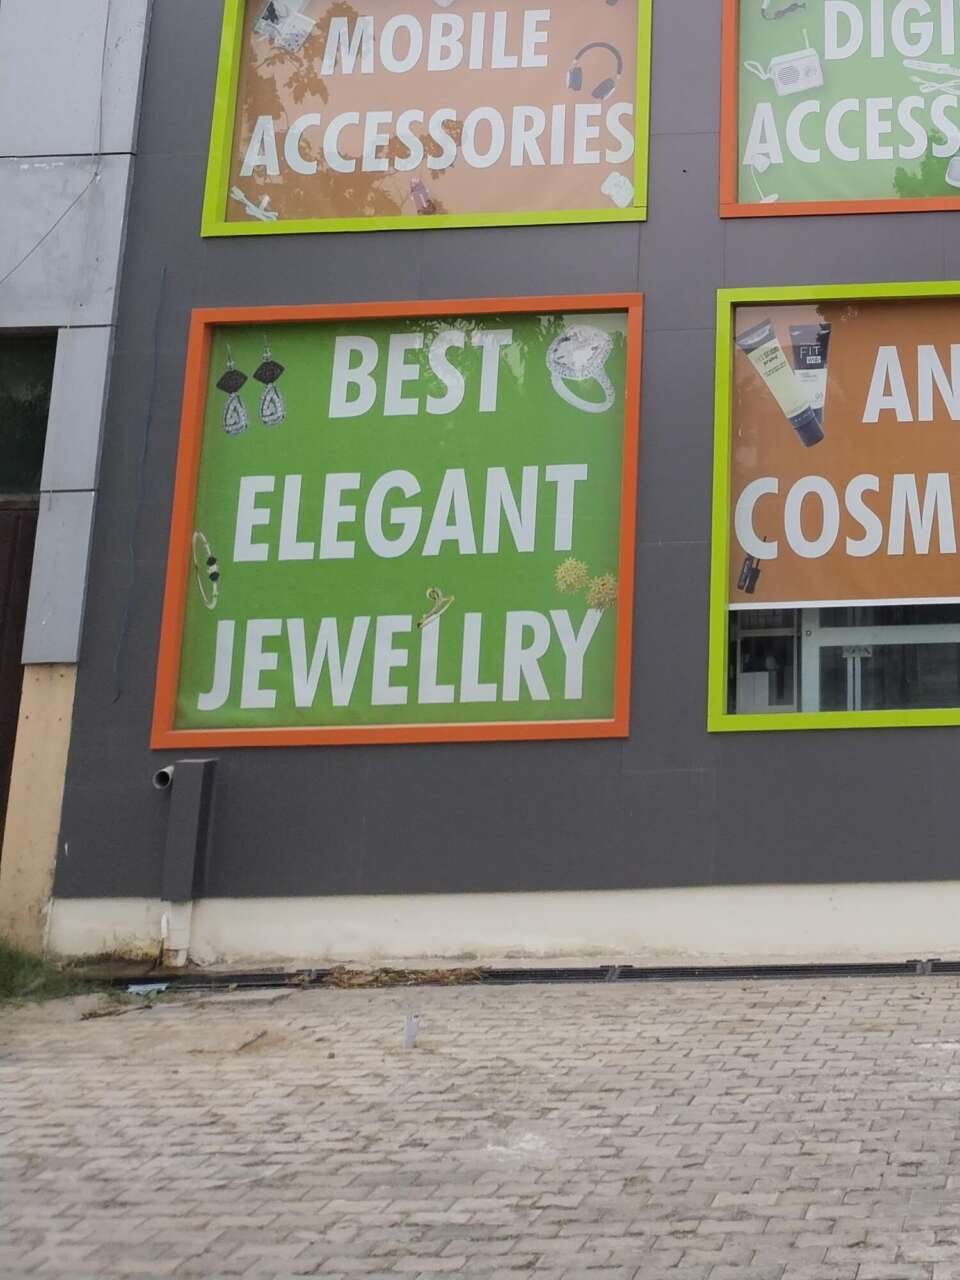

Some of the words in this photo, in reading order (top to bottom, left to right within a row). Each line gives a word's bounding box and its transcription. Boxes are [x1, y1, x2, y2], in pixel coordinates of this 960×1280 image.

[319, 8, 552, 76] MOBILE
[239, 102, 636, 178] ACCESSORIES
[327, 328, 514, 419] BEST
[232, 463, 588, 563] ELEGANT
[197, 607, 606, 712] JEWELLRY
